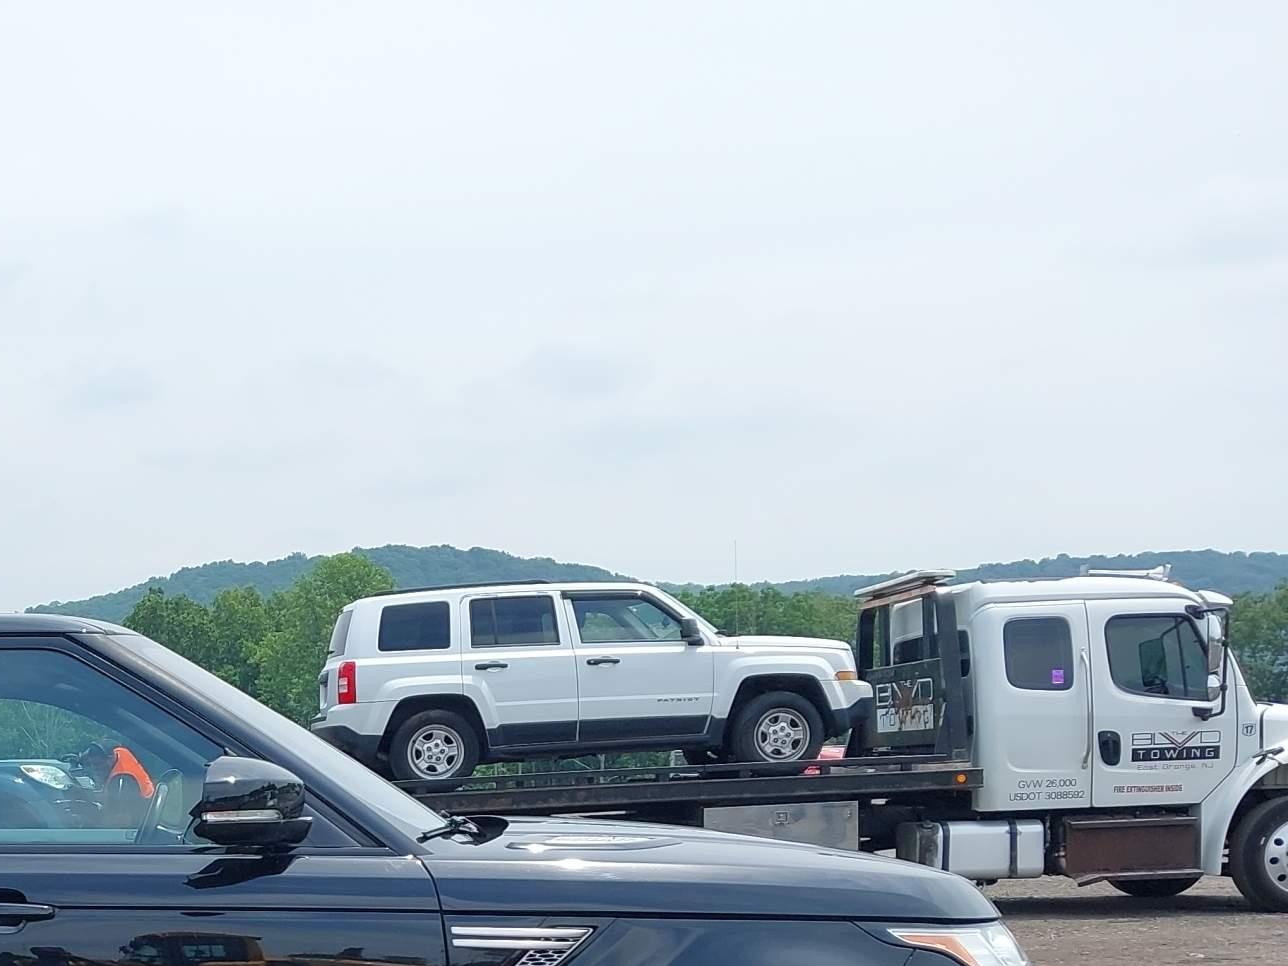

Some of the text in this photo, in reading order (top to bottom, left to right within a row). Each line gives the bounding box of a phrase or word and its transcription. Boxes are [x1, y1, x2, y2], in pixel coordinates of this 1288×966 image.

[876, 678, 933, 706] BVD
[879, 709, 930, 730] TOWG
[1136, 749, 1215, 760] TOWING
[1017, 778, 1077, 789] GVW 26,000
[1113, 783, 1183, 794] FIRE EXTINGUISHER INSIDE
[1009, 791, 1042, 801] USDOT
